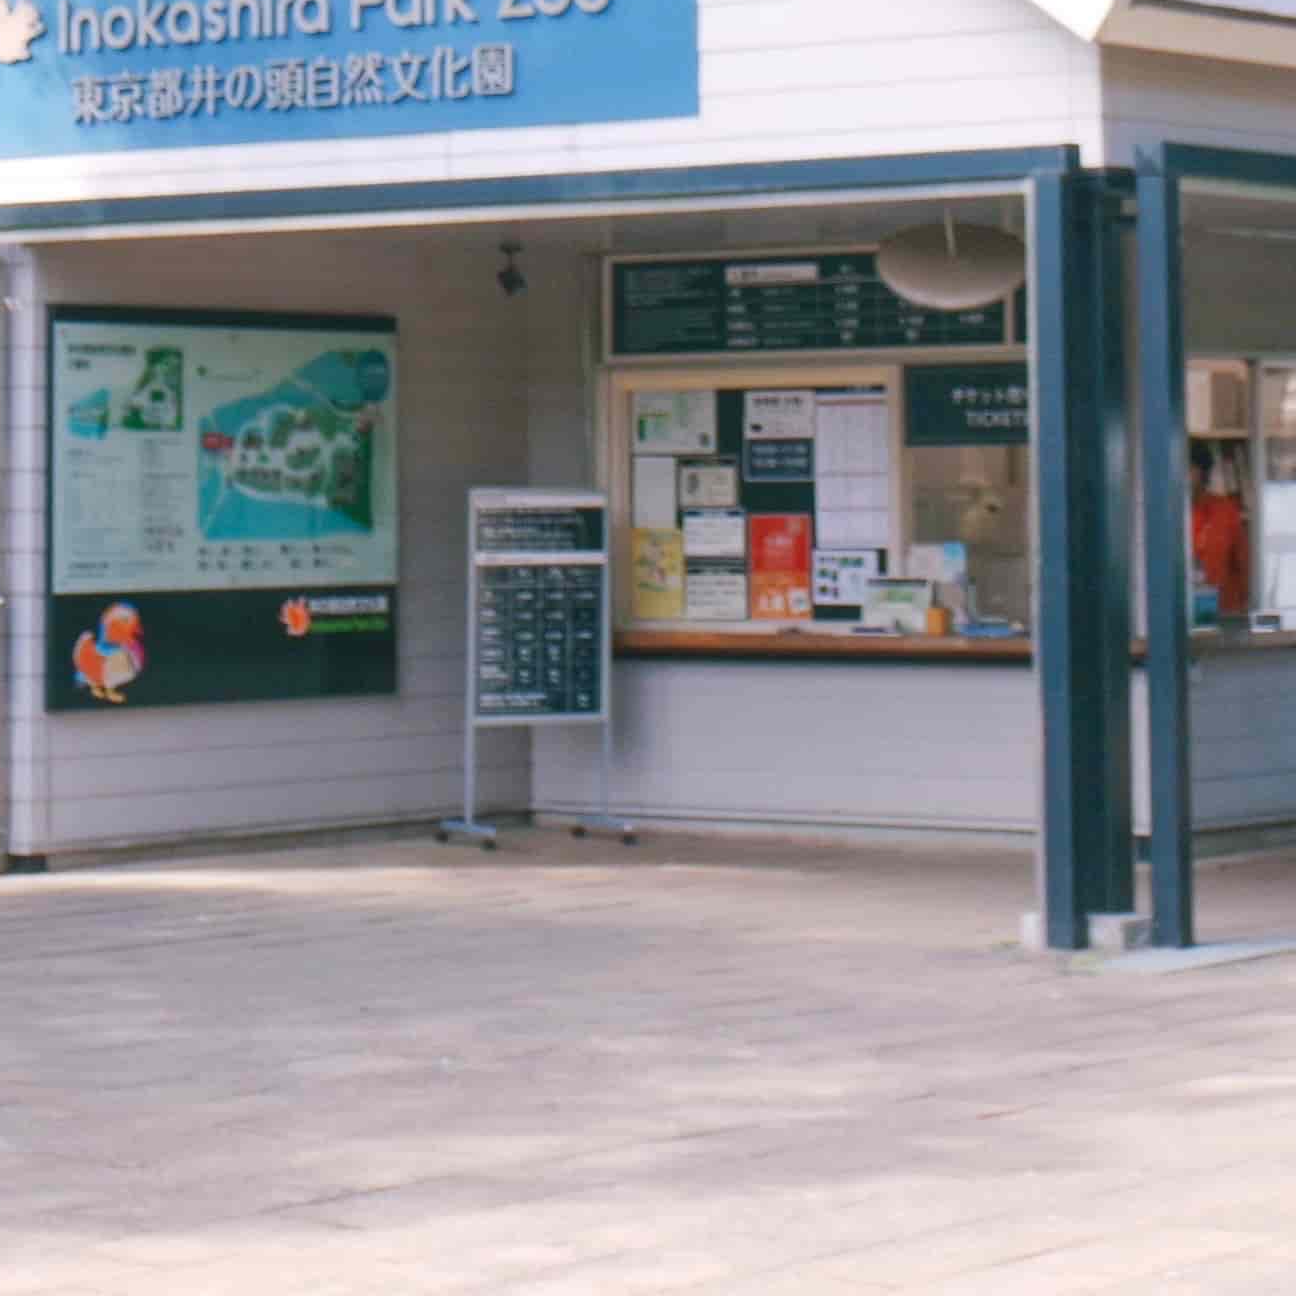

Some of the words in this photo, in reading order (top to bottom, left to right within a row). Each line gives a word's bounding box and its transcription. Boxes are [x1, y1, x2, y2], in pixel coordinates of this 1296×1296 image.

[72, 42, 516, 125] 東京都井の頭自然文化園
